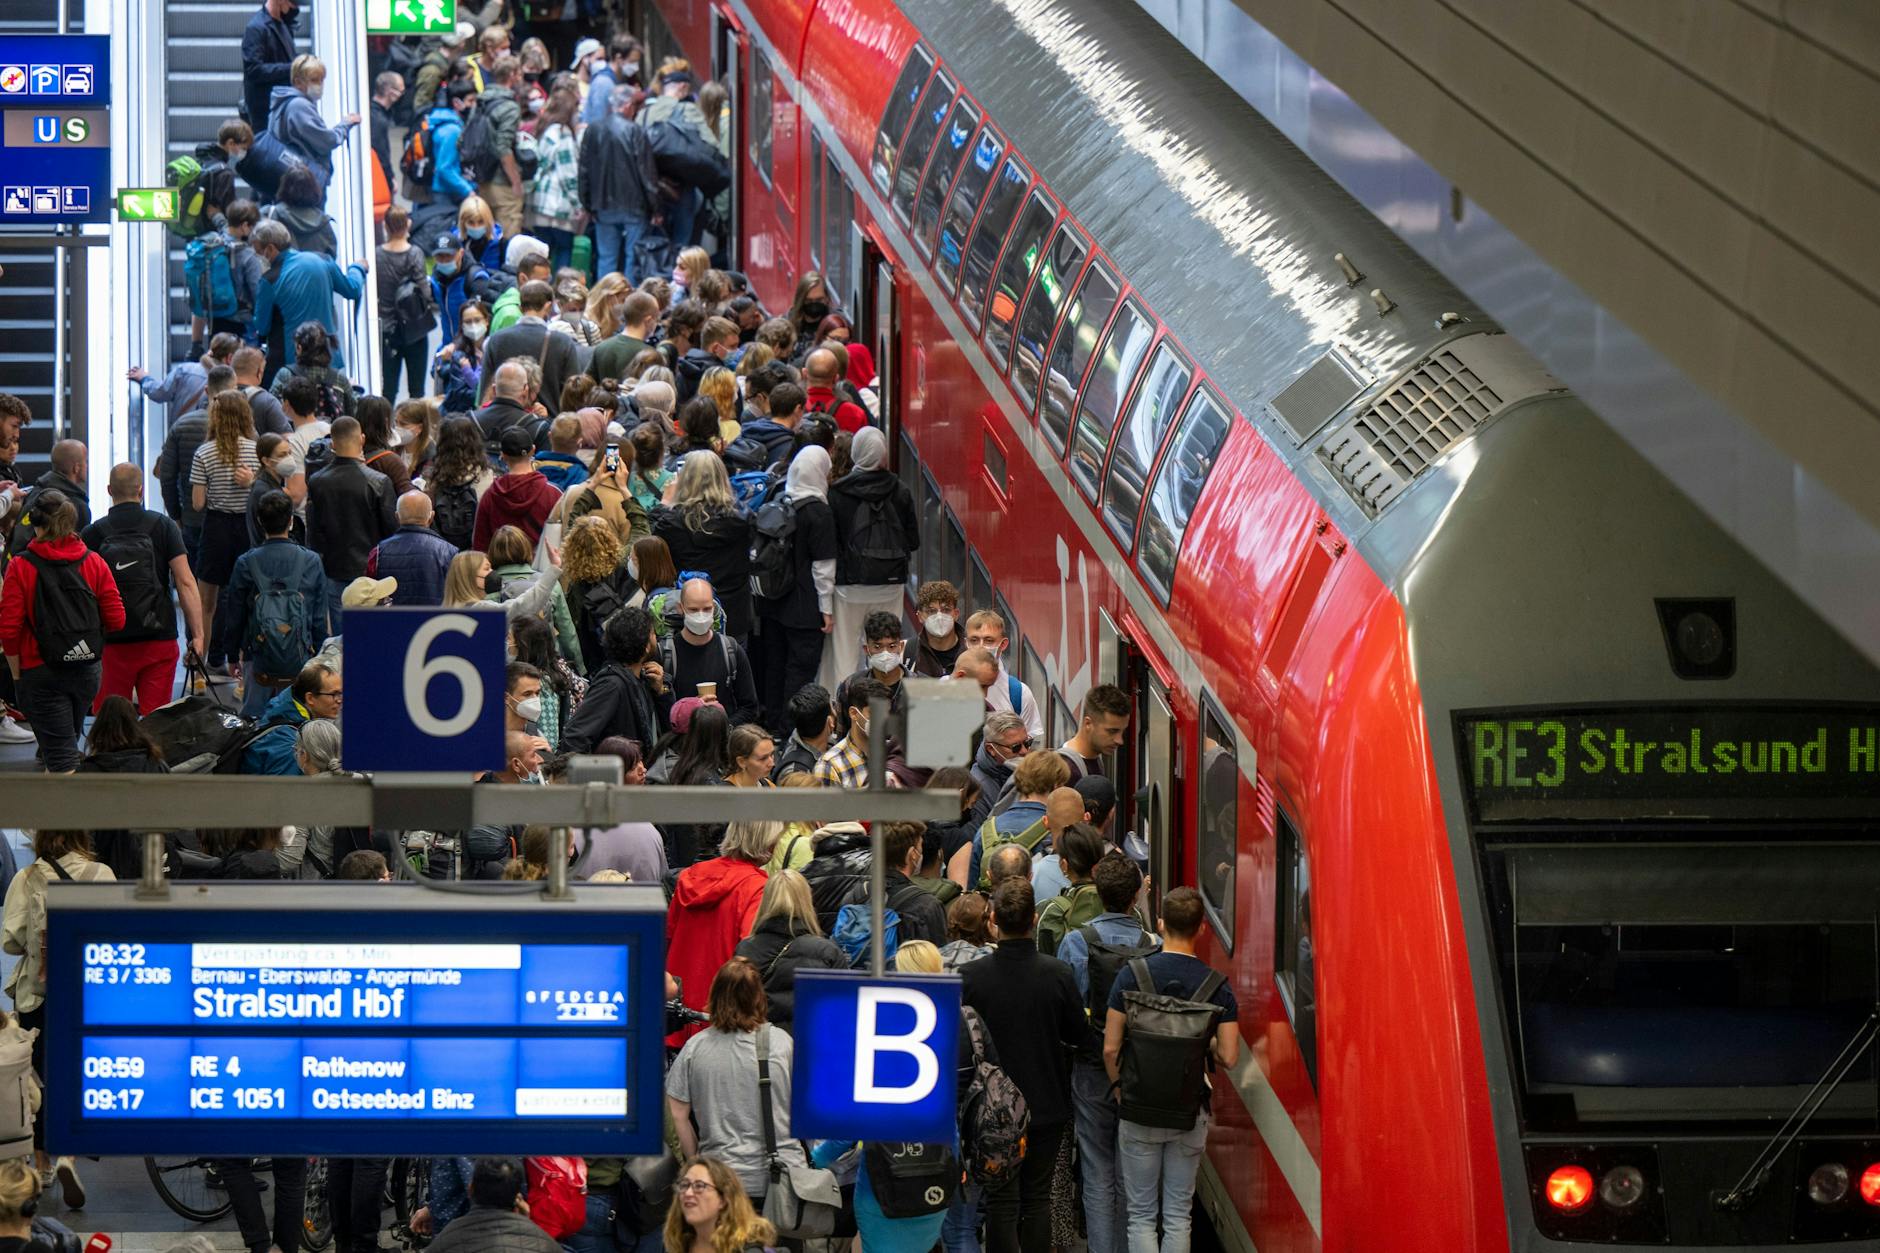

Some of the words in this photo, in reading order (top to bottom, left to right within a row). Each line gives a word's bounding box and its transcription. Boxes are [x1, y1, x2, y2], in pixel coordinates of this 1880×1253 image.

[38, 73, 53, 94] P
[38, 118, 56, 142] U
[66, 118, 86, 142] S
[63, 652, 95, 661] adidas
[403, 613, 485, 737] 6
[1474, 721, 1566, 787] RE3
[1580, 727, 1828, 774] Stralsund
[1848, 727, 1880, 773] H
[84, 943, 146, 966] 08:32
[84, 967, 105, 984] RE
[107, 967, 118, 984] 3
[133, 967, 172, 984] 3306
[191, 967, 246, 984] Bernau
[259, 967, 352, 985] Eberswalde
[365, 968, 462, 988] Angermünde
[193, 987, 342, 1018] Stralsund
[353, 987, 405, 1018] Hbf
[853, 986, 940, 1104] B
[83, 1056, 145, 1079] 08:59
[190, 1055, 219, 1077] RE
[225, 1055, 241, 1077] 4
[302, 1056, 406, 1078] Rathenow
[83, 1088, 145, 1110] 09:17
[190, 1087, 224, 1109] ICE
[232, 1087, 285, 1109] 1051
[312, 1087, 426, 1110] Ostseebad
[431, 1087, 475, 1110] Binz
